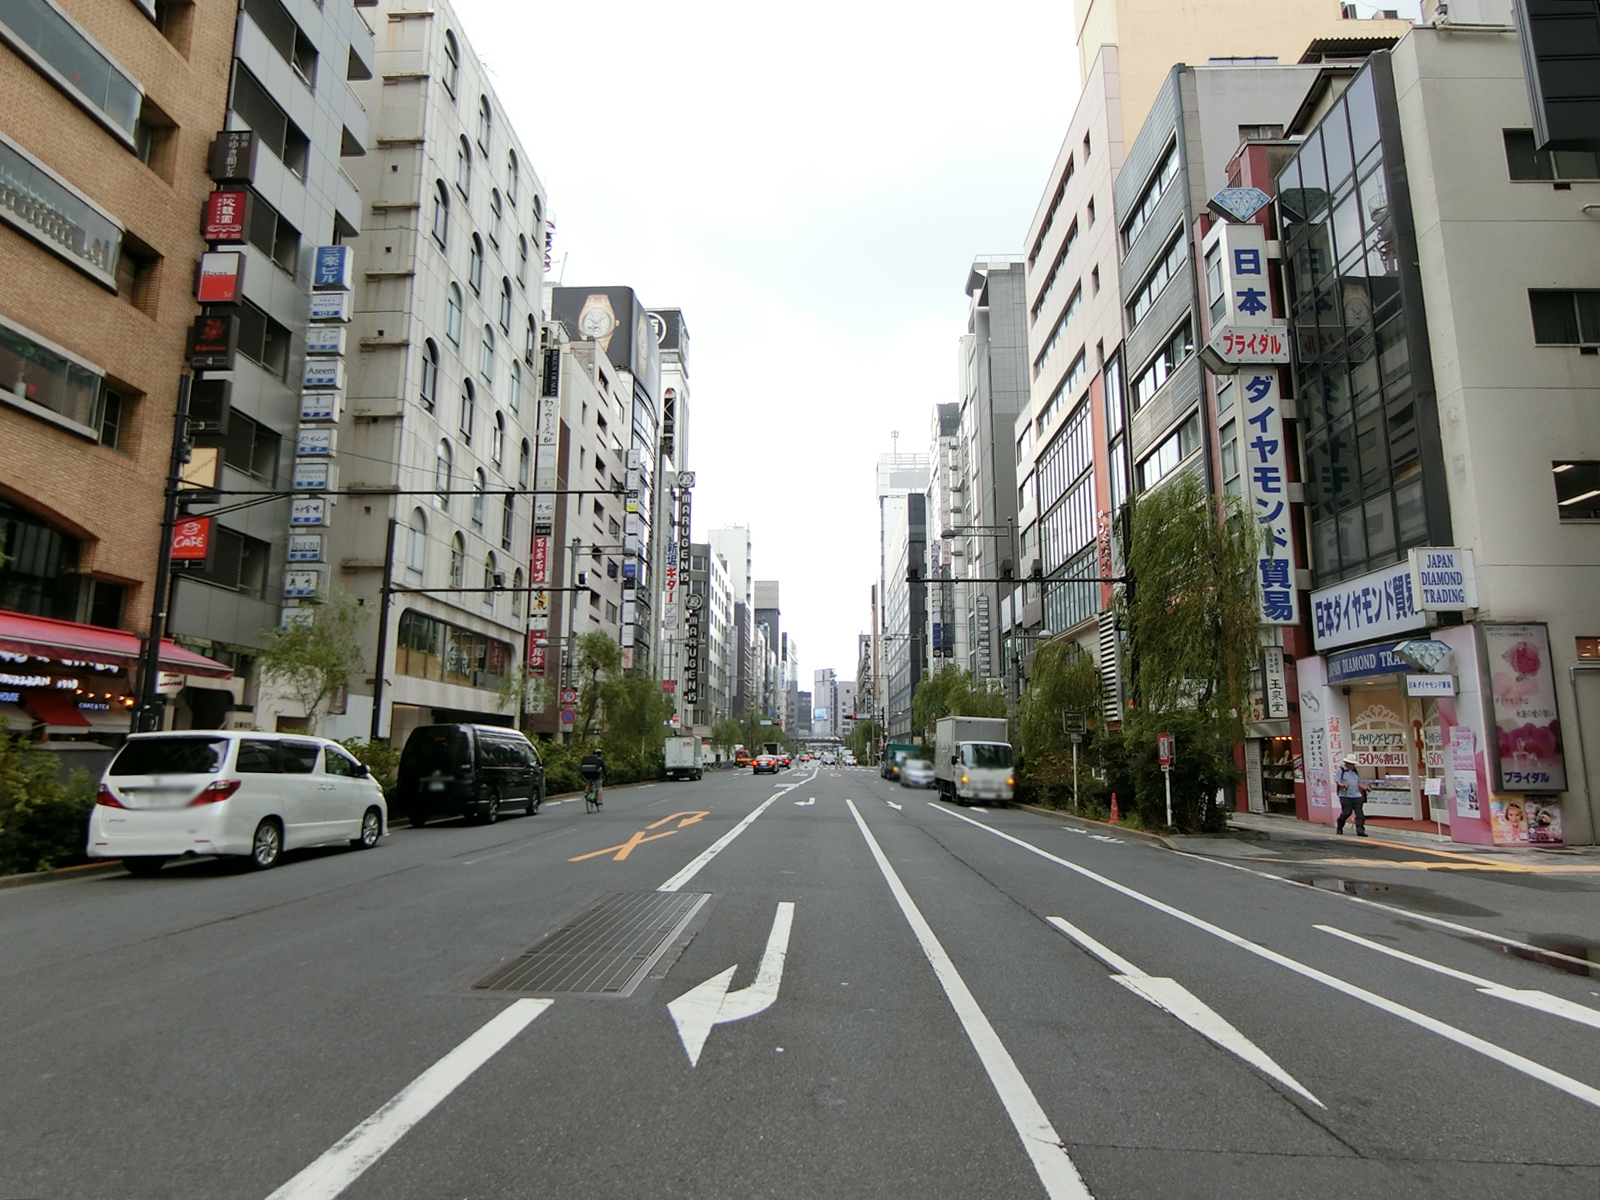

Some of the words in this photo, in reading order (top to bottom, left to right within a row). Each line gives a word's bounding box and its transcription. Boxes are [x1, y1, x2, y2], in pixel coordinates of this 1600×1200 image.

[225, 132, 239, 178] みゆき館ビル
[322, 247, 340, 283] 三楽ビル
[1234, 249, 1268, 316] 日本
[1223, 333, 1282, 356] ブライダル
[206, 356, 213, 365] 4
[307, 367, 335, 375] Aseem
[199, 420, 205, 430] 3
[681, 494, 691, 571] MARUGEN
[183, 559, 190, 568] 1
[1426, 553, 1454, 569] JAPAN
[666, 542, 677, 603] 新堀ギター
[680, 572, 690, 582] 15
[1420, 571, 1463, 587] DIAMOND
[1423, 588, 1465, 604] TRADING
[1315, 571, 1419, 639] 日本ダイヤモンド貿易
[688, 616, 698, 690] MARUGEN
[1342, 653, 1376, 674] DIAMOND
[1379, 651, 1406, 668] TRA
[1408, 681, 1452, 690] 日本ダイヤモンド貿易
[687, 692, 697, 701] 15
[1269, 678, 1284, 713] 玉泉堂
[1504, 771, 1550, 785] ブライダル
